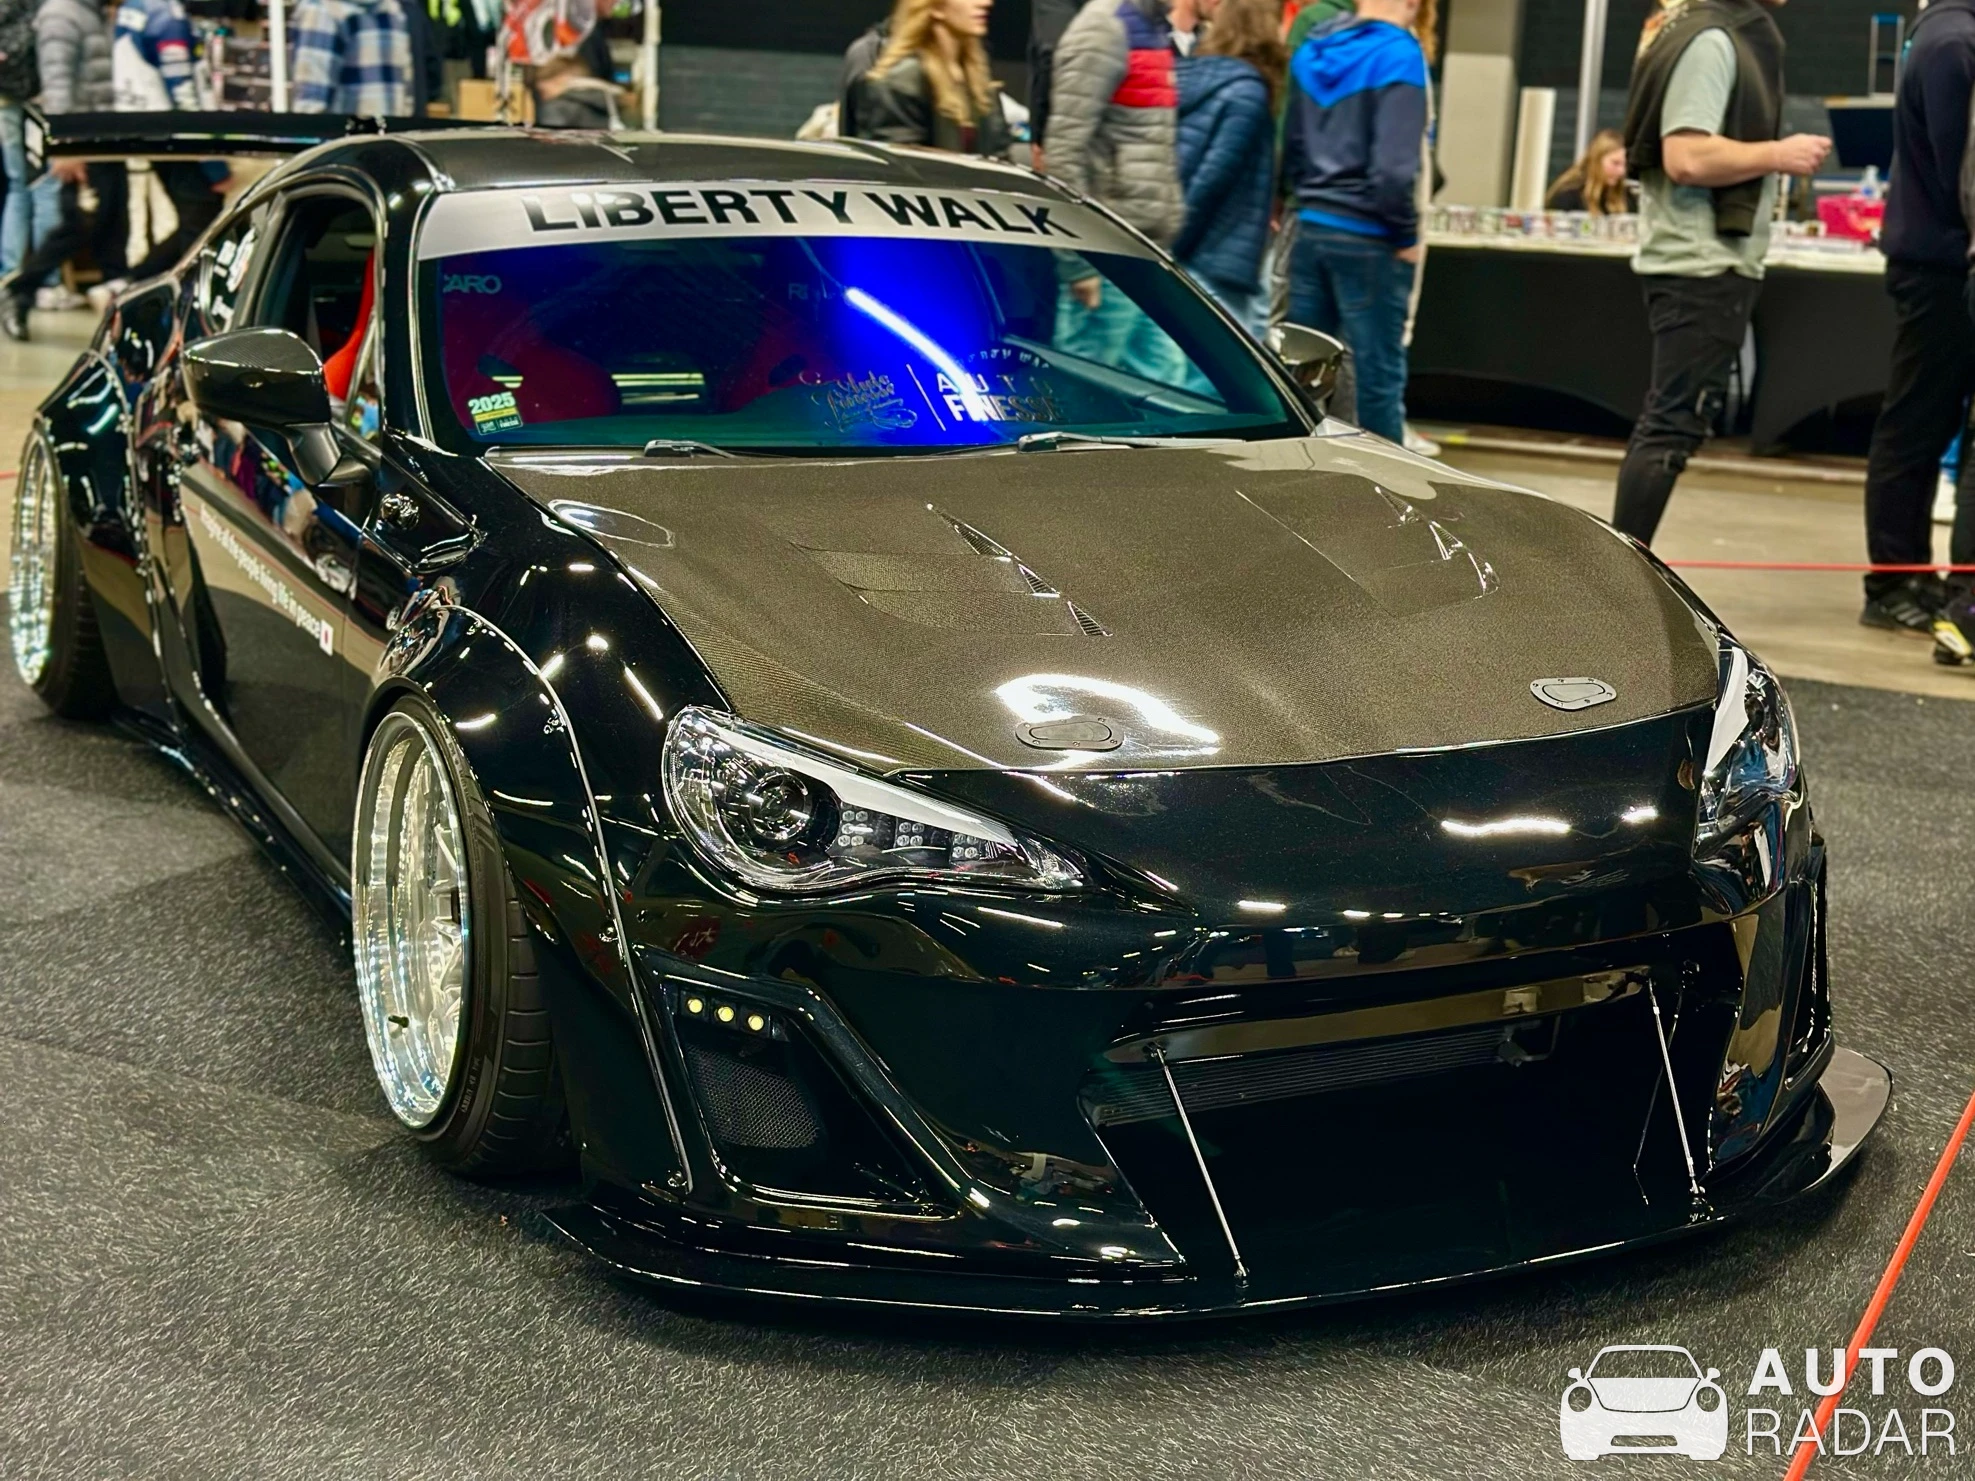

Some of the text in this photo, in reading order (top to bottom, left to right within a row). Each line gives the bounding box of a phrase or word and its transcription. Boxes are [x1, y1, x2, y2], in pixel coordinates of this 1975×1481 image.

[521, 189, 1082, 239] LIBERTY WALK
[468, 391, 516, 415] 2025
